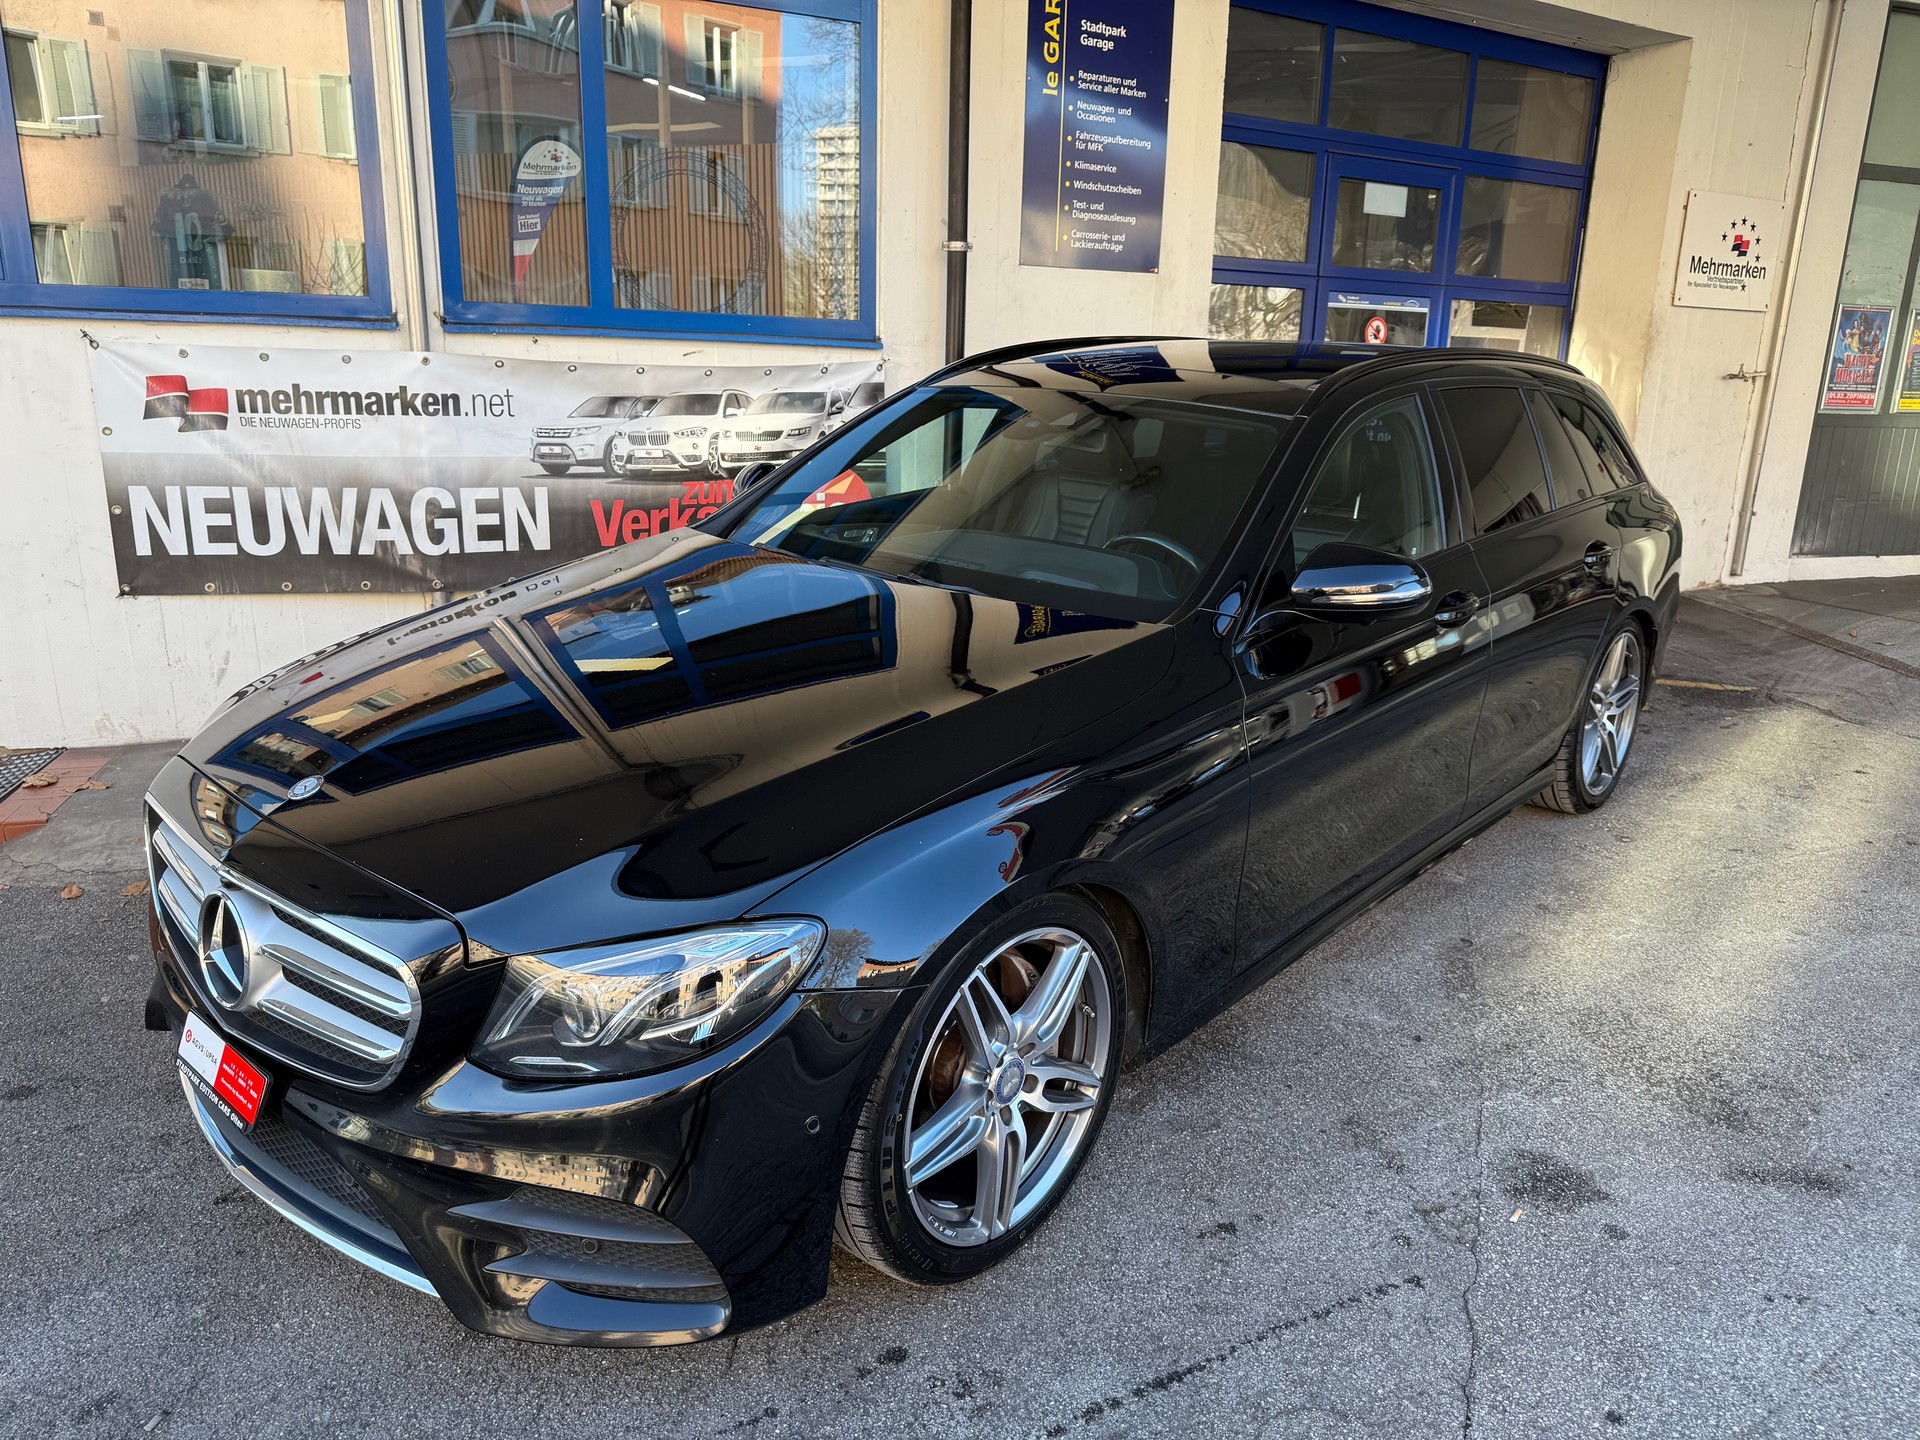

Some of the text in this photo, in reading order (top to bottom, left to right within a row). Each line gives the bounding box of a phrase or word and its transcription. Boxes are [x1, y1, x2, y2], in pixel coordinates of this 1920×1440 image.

[1080, 19, 1127, 38] Stadtpark
[1080, 34, 1114, 51] Garage
[1042, 71, 1059, 96] le
[1078, 70, 1137, 87] Reparaturen und
[1078, 80, 1147, 98] Service aller Marken
[1077, 100, 1132, 116] Neuwagen und
[1076, 110, 1116, 124] Occasionen
[1075, 130, 1152, 150] Fahrzeugaufbereitung
[1075, 140, 1104, 152] für MFK
[522, 162, 577, 171] Mehrmarken
[1074, 160, 1117, 173] Klimaservice
[517, 183, 564, 196] Neuwagen
[1073, 180, 1142, 195] Windschutzscheiben
[1072, 200, 1104, 211] Test- und
[520, 220, 539, 231] Hier
[1072, 210, 1136, 226] Diagnoseauslesung
[1071, 230, 1126, 242] Carrosserie- und
[1070, 239, 1124, 253] Lackieraufträge
[1689, 255, 1767, 280] Mehrmarken
[1693, 281, 1712, 289] Spezialist
[1718, 283, 1739, 291] Neuwagen
[1706, 275, 1745, 285] Vertriebspartner
[235, 382, 516, 419] mehrmarken.net
[1846, 392, 1875, 400] ZOFINGEN
[239, 416, 362, 431] DIE NEUWAGEN-PROFIS
[127, 485, 551, 558] NEUWAGEN
[175, 1058, 201, 1087] STADTPARK
[200, 1081, 218, 1106] EDITION
[217, 1100, 231, 1117] CARS
[230, 1112, 244, 1130] Olten
